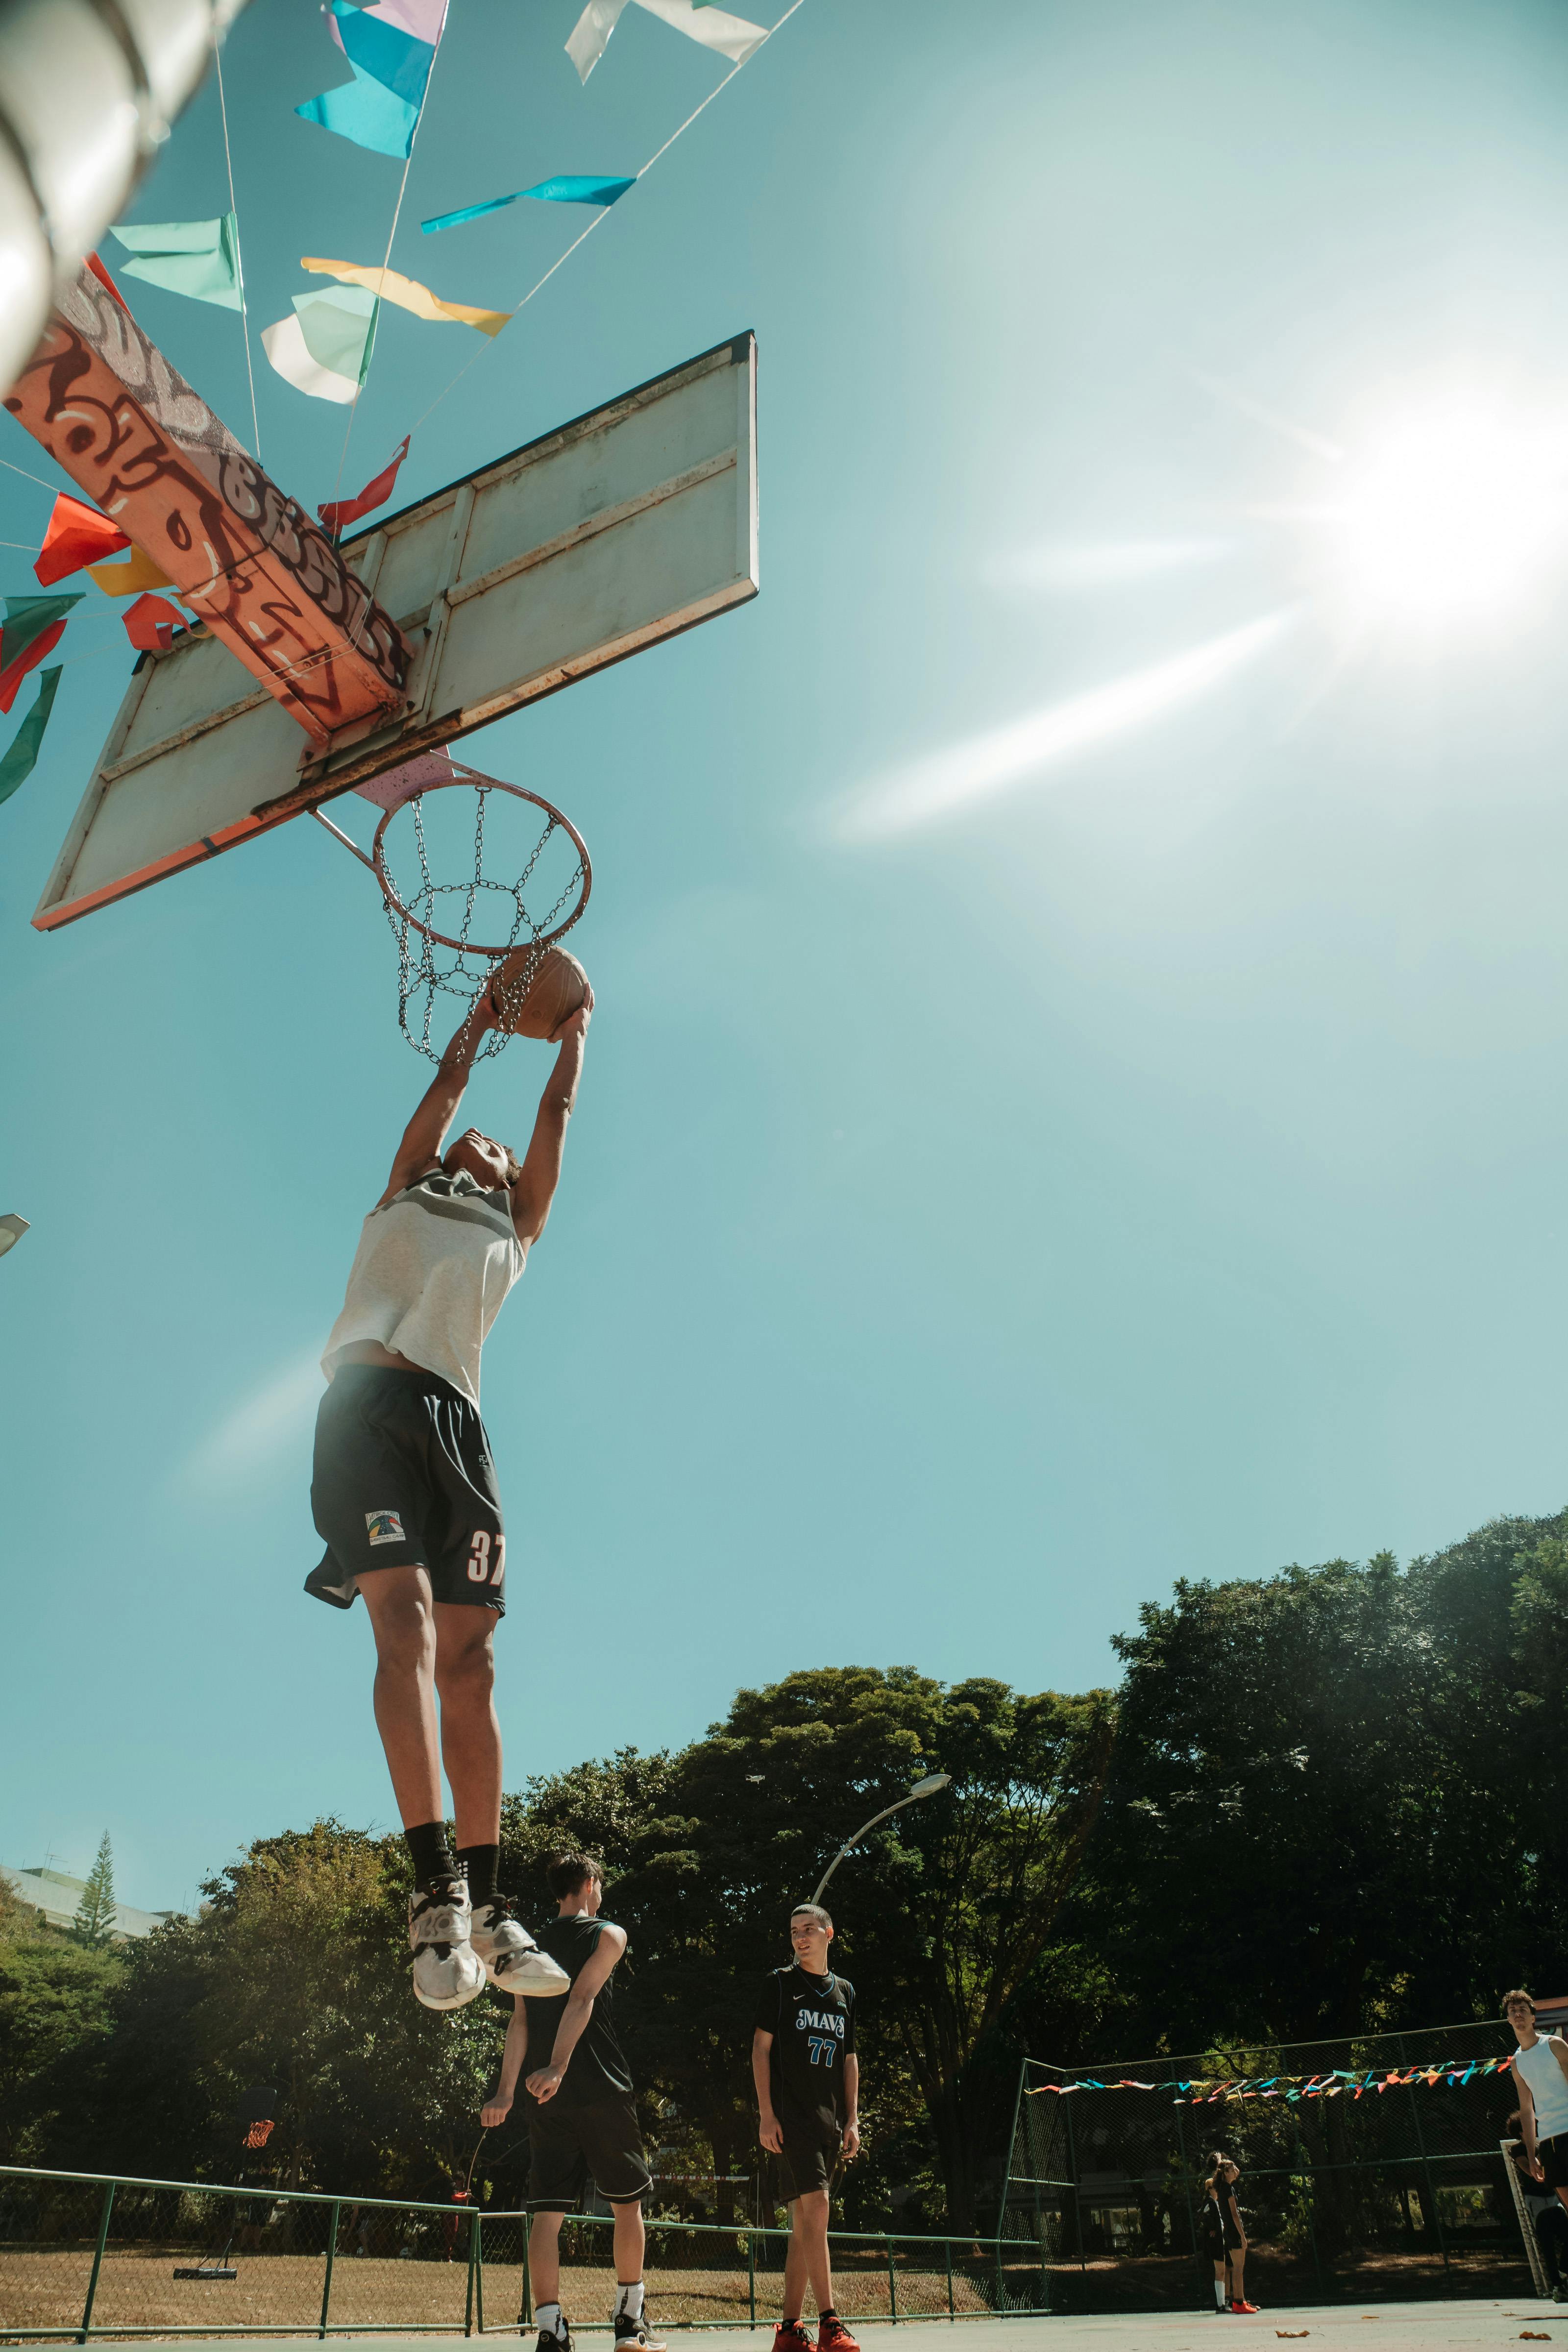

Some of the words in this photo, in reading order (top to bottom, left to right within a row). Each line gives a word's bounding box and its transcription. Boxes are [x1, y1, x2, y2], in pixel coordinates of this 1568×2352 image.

[467, 1530, 505, 1586] 37
[796, 2009, 844, 2038] MAVS
[808, 2036, 836, 2067] 77
